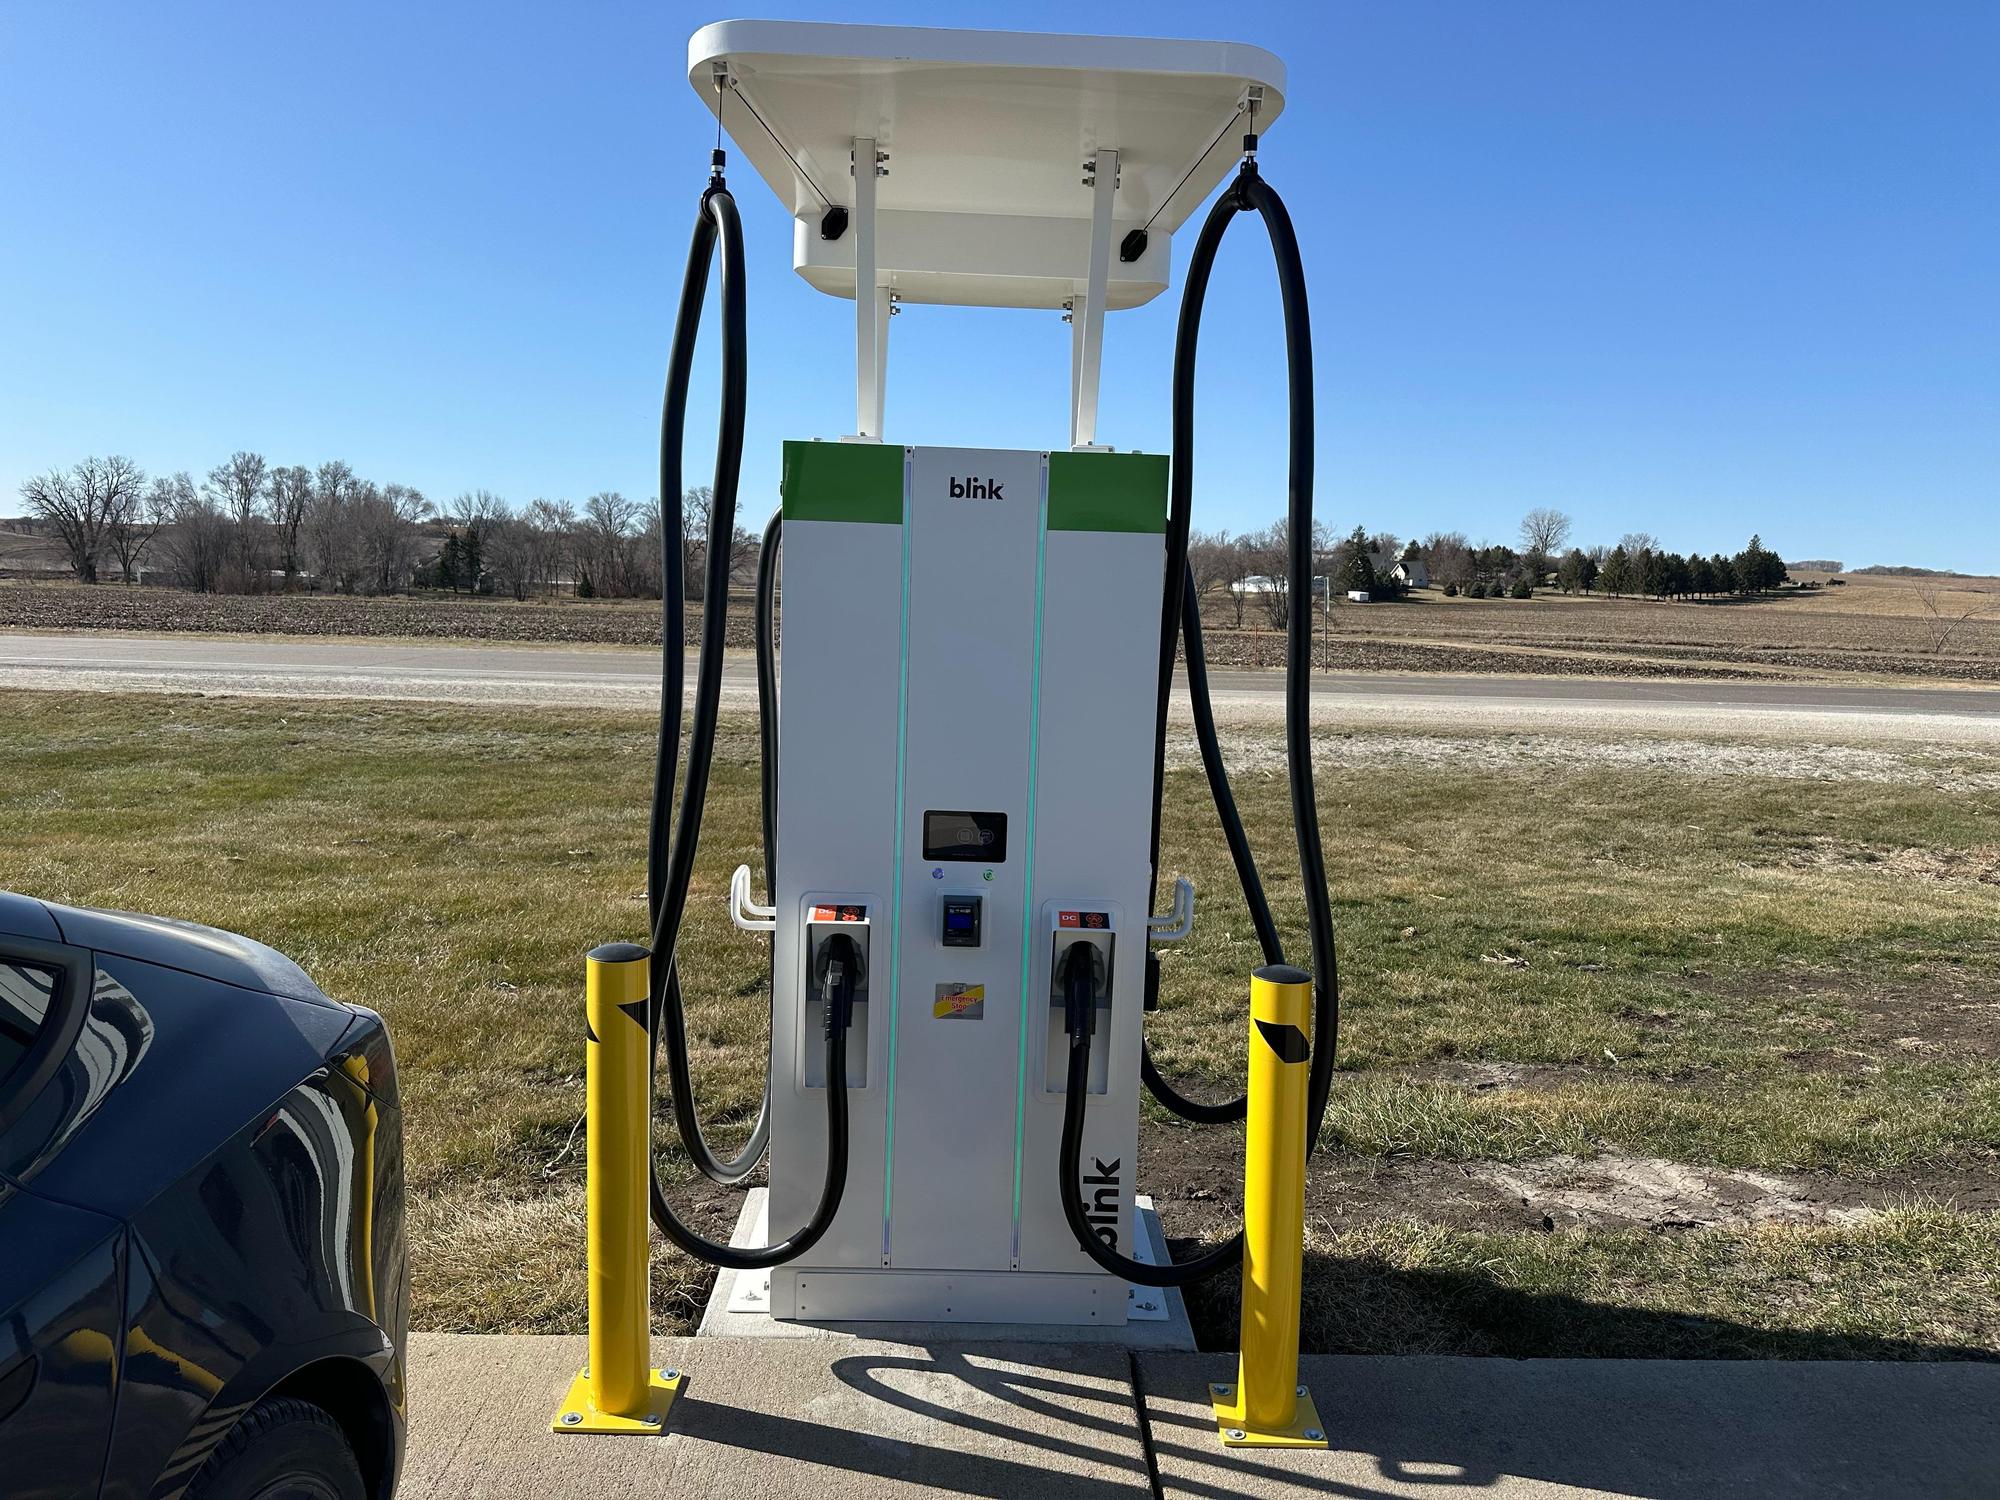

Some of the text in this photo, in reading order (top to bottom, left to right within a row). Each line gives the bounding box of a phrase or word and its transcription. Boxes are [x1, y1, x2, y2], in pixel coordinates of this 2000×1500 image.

[950, 477, 1004, 500] blink
[941, 993, 978, 1004] Emergency
[952, 1003, 967, 1011] Stop
